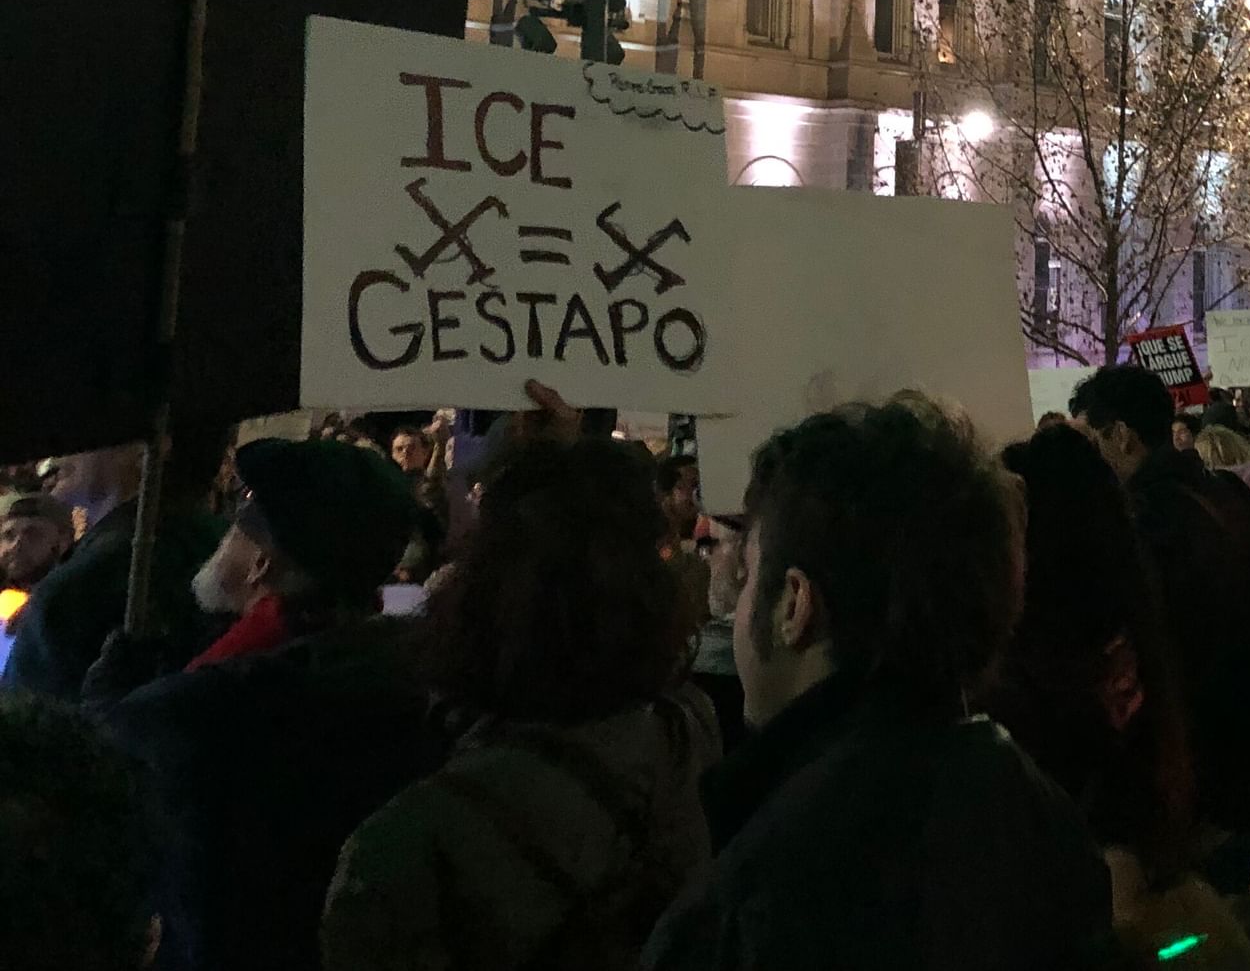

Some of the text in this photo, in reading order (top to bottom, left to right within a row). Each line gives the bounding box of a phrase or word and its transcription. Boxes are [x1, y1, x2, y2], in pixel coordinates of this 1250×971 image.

[400, 72, 576, 189] ICE
[348, 269, 706, 373] GESTAPO
[1167, 336, 1185, 351] SE
